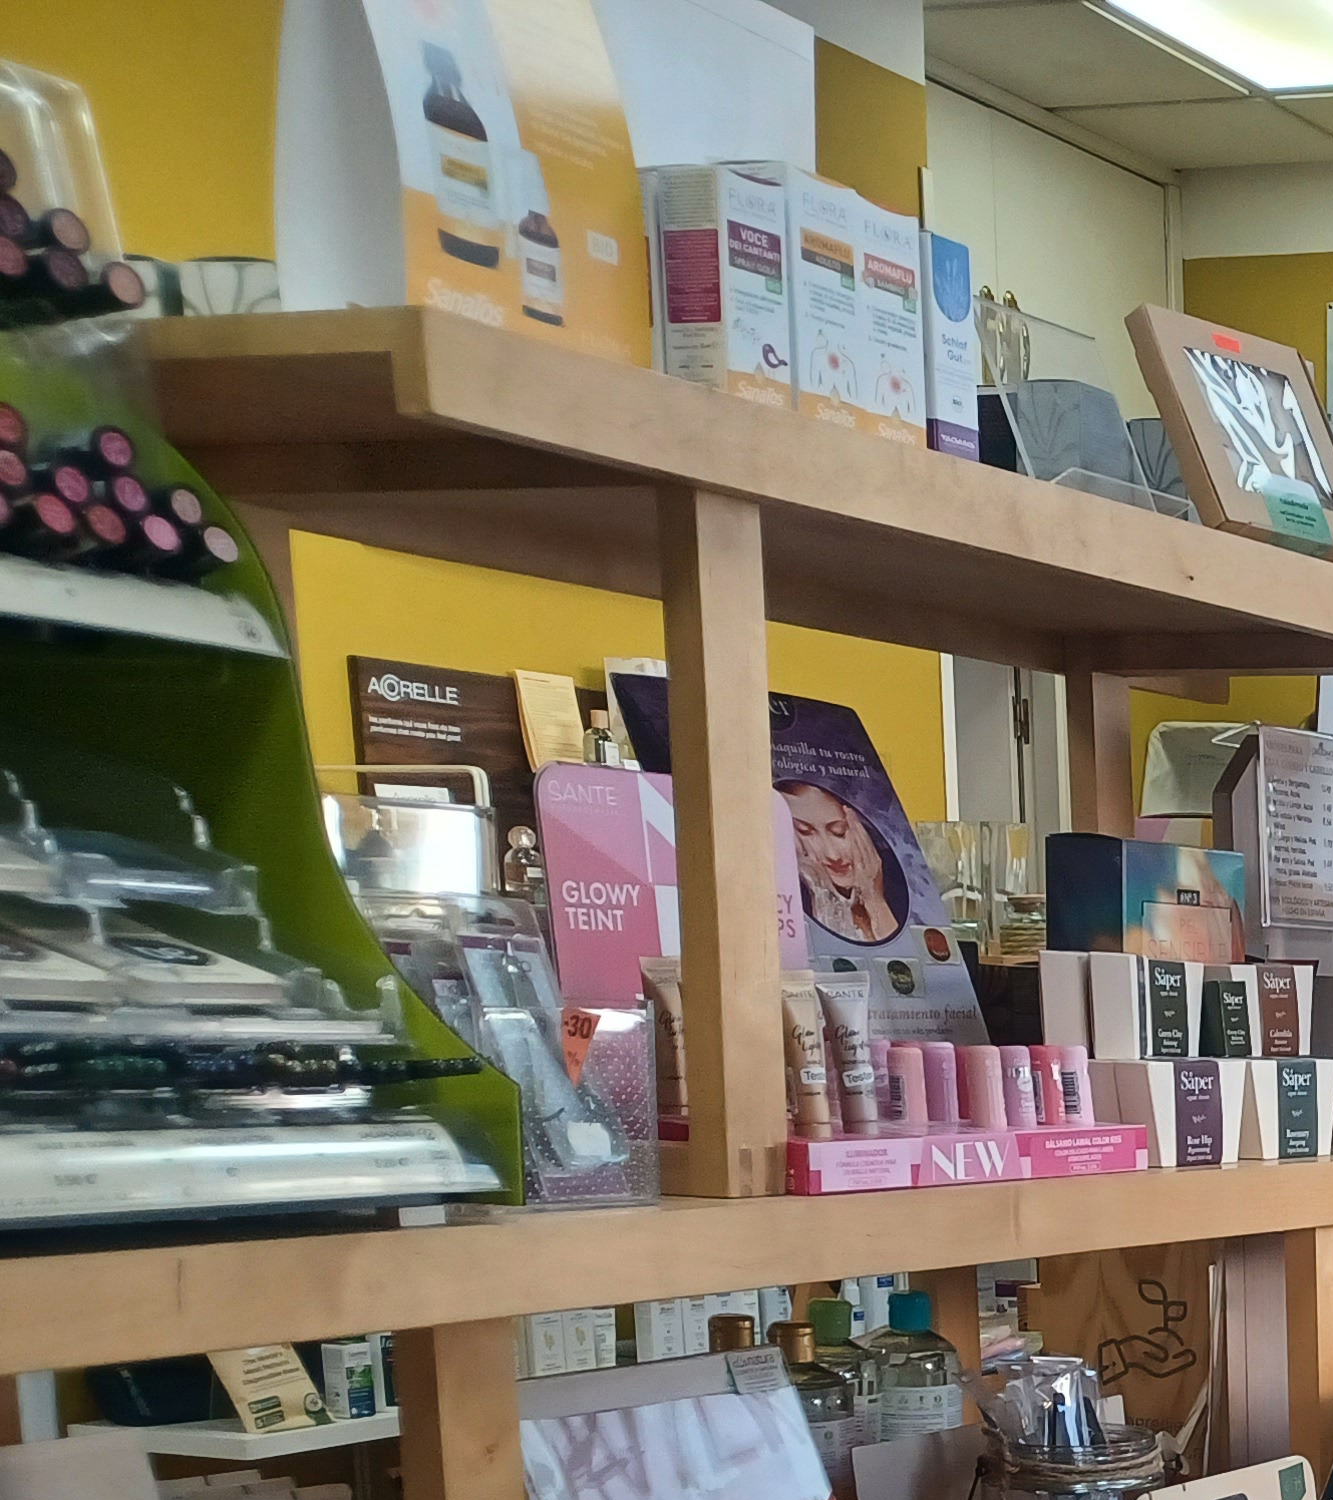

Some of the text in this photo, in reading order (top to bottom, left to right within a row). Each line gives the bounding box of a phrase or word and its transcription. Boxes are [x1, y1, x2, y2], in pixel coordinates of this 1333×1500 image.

[740, 227, 769, 248] VOCE
[867, 260, 912, 284] AROMAFLU
[368, 673, 461, 706] ACORELLE
[819, 748, 832, 759] tu
[828, 765, 870, 779] natural
[549, 781, 617, 807] SANTE
[562, 880, 640, 907] GLOWY
[564, 907, 625, 932] TEINT
[564, 1014, 593, 1040] -30
[868, 1004, 978, 1025] tratamiento facial
[931, 1137, 1011, 1182] NEW
